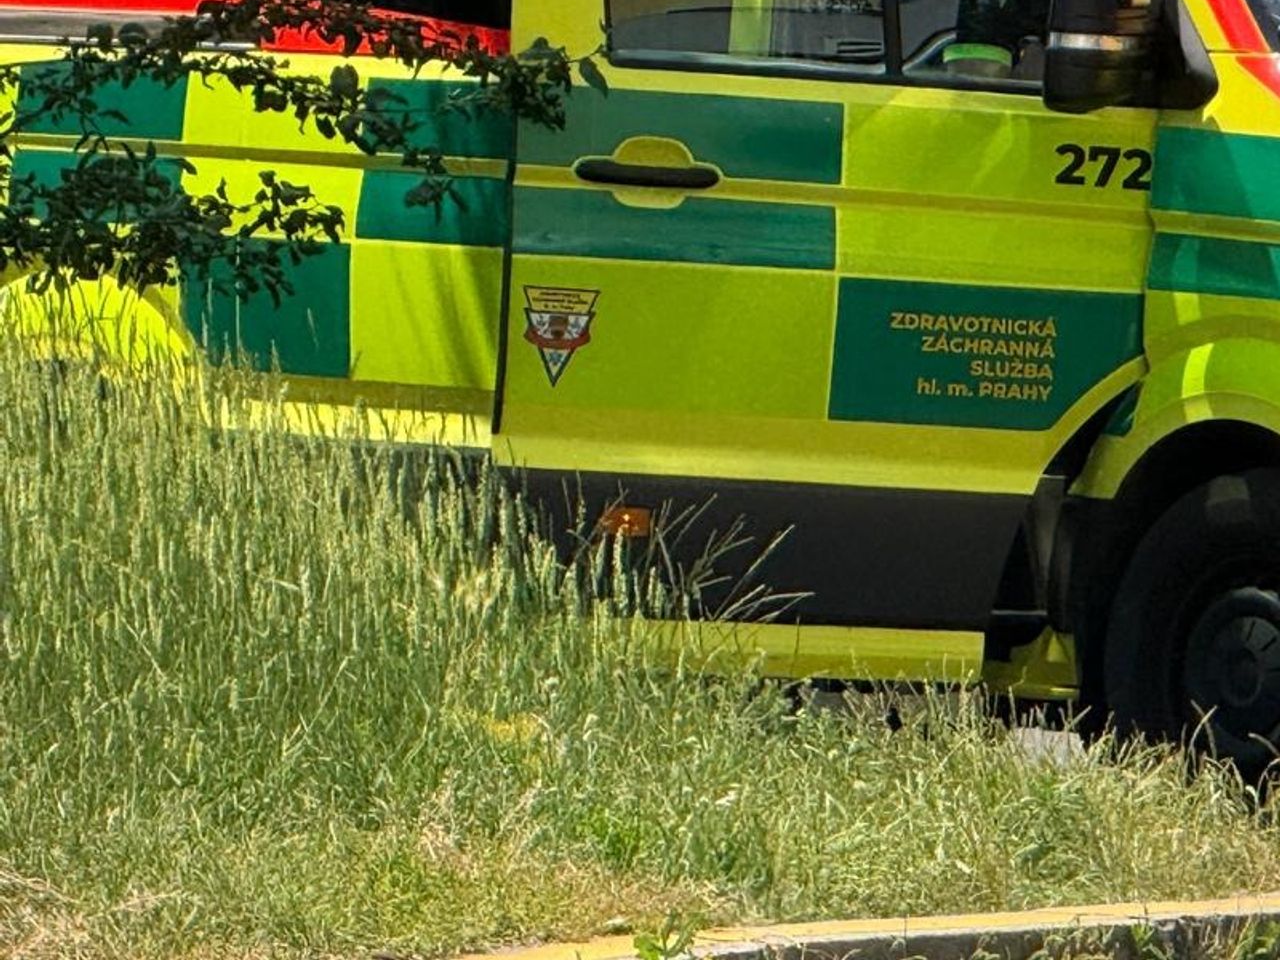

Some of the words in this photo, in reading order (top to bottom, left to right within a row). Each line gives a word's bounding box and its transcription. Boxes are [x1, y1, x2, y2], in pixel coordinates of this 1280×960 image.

[1055, 143, 1152, 191] 272
[890, 311, 1057, 338] ZDRAVOTNICKÁ
[921, 333, 1055, 359] ZÁCHRANNÁ
[969, 358, 1053, 381] SLUŽBA
[917, 377, 941, 395] hl.
[948, 382, 973, 398] m.
[979, 382, 1053, 402] PRAHY
